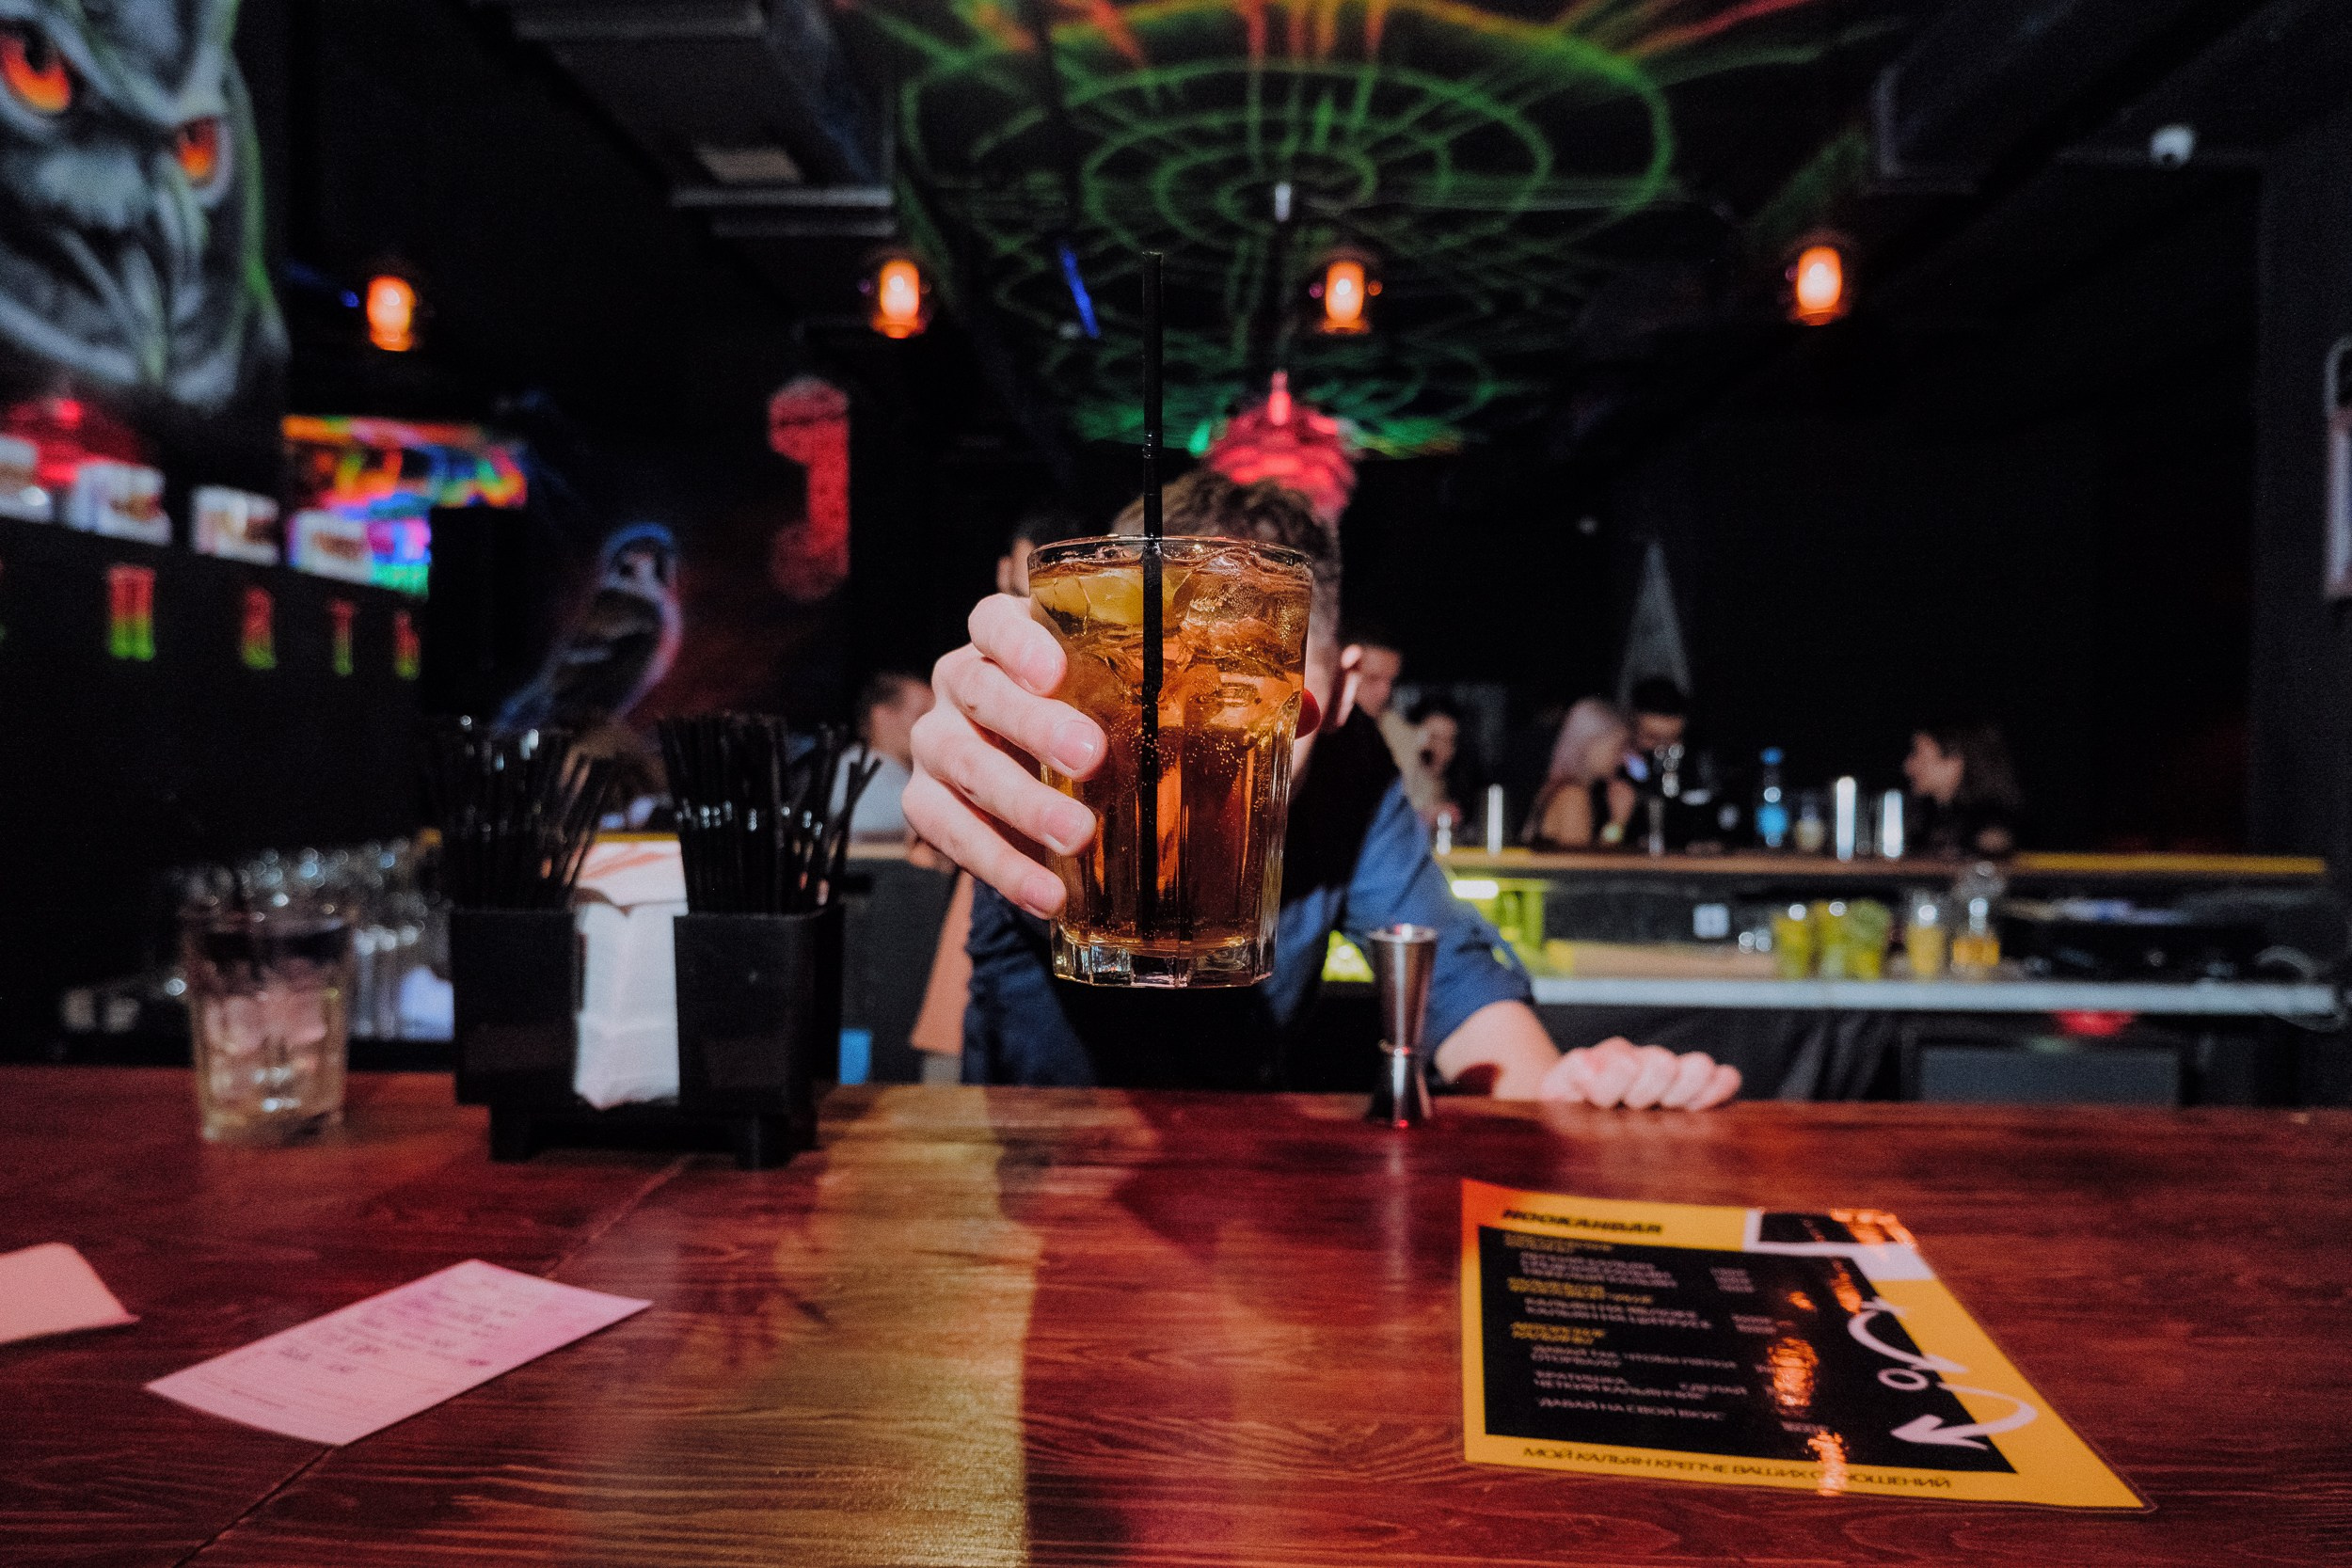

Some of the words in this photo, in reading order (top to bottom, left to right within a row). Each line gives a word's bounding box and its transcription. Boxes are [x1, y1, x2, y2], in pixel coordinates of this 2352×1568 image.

[1524, 1447, 1572, 1459] МОЙ
[1576, 1451, 1651, 1466] КАЛЬЯН
[1655, 1457, 1727, 1473] КРЕПЧЕ
[1732, 1464, 1806, 1478] ВАШИХ
